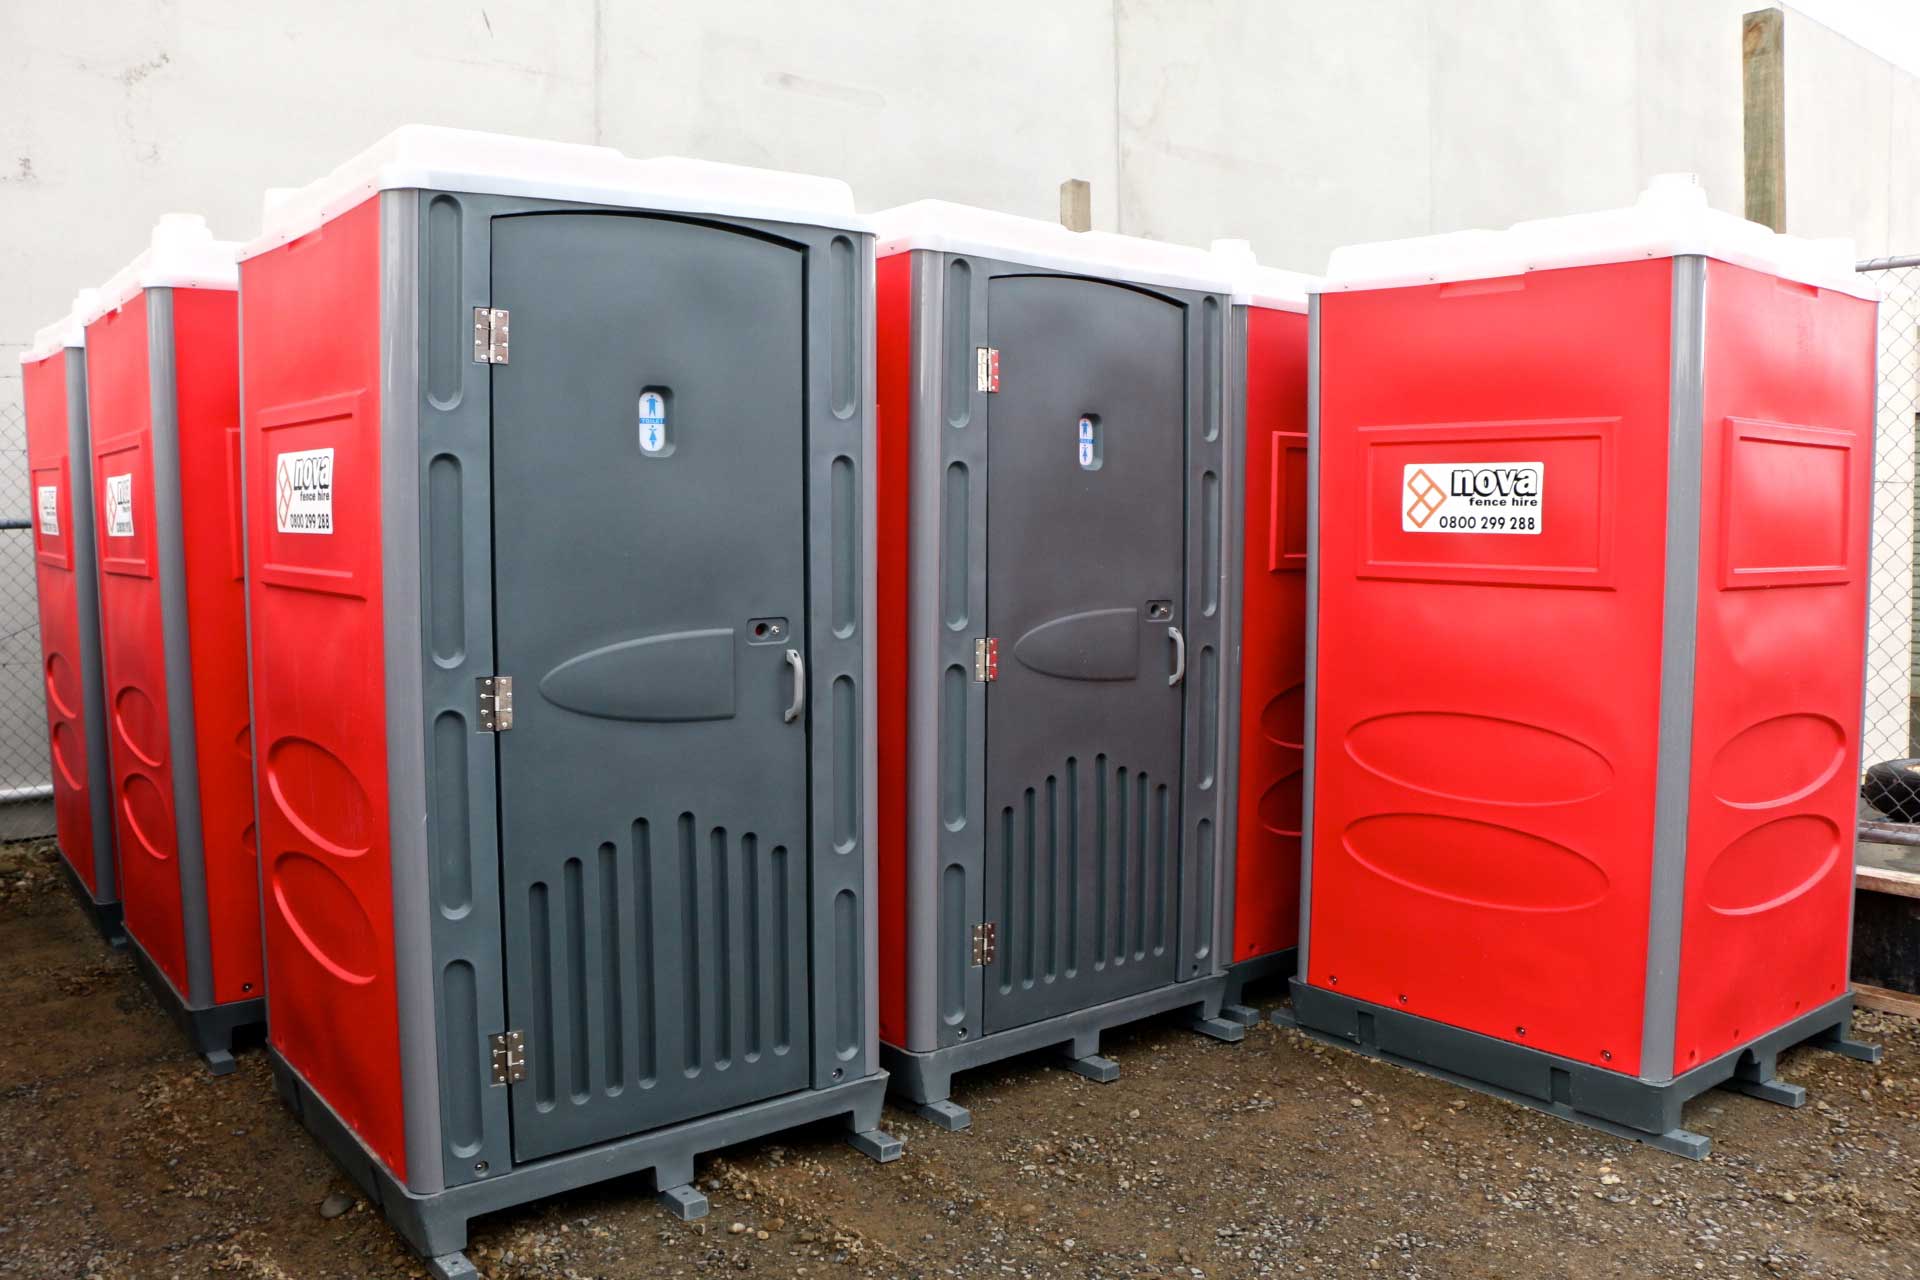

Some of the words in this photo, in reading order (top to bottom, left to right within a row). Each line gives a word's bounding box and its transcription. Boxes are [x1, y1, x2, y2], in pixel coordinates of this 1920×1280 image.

[294, 456, 330, 490] nova
[1451, 469, 1537, 497] nova
[1469, 497, 1507, 507] fence
[1512, 497, 1538, 507] hire
[1439, 516, 1476, 529] 0800
[1481, 516, 1505, 530] 299
[1510, 517, 1535, 530] 288
